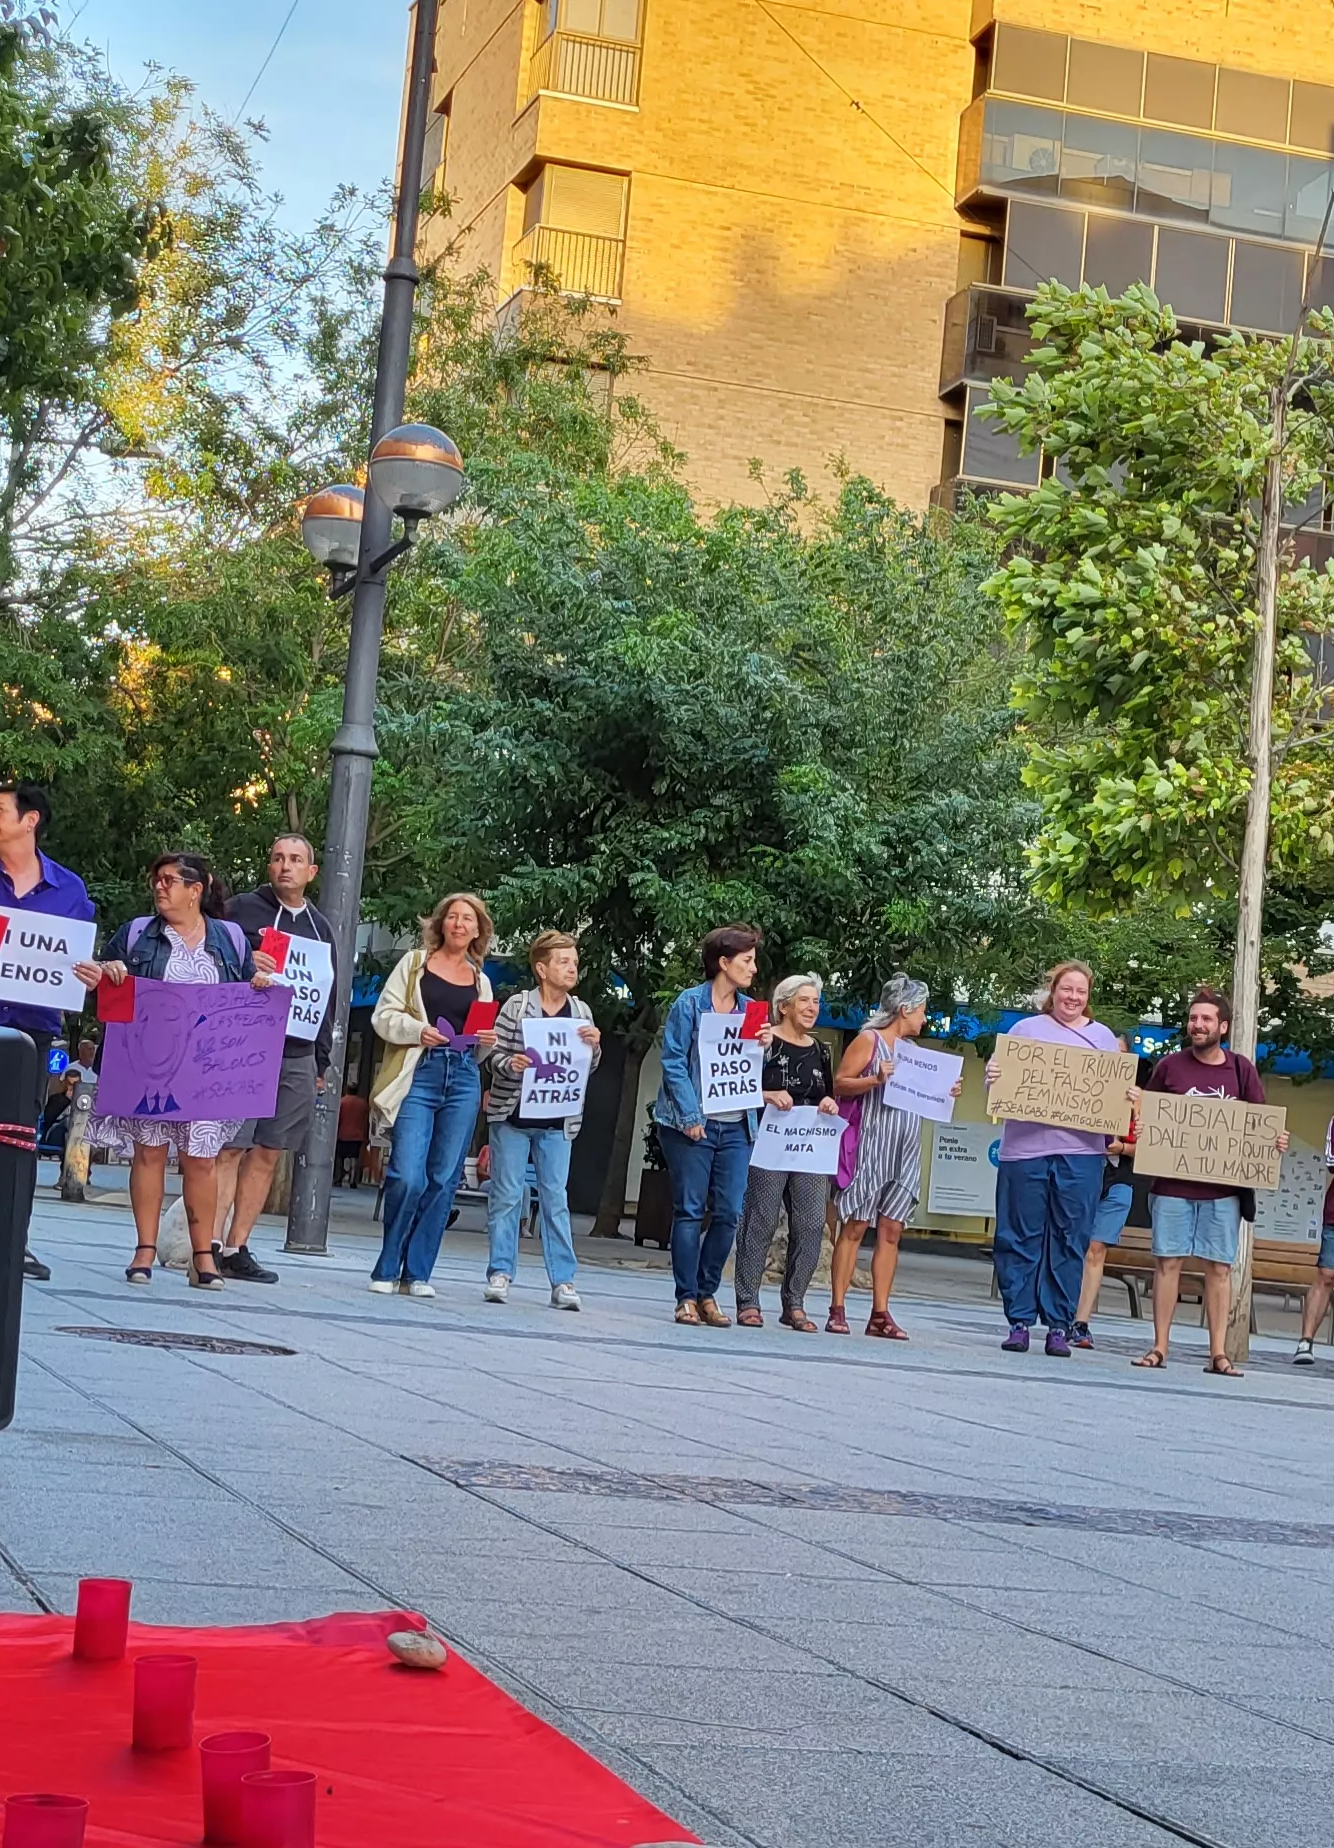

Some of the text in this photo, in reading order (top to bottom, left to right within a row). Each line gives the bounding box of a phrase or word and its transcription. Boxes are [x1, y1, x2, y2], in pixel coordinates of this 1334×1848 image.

[4, 929, 69, 955] I UNA
[289, 950, 307, 967] NI
[284, 968, 314, 983] UN
[292, 1005, 321, 1025] RÁS
[547, 1032, 567, 1046] NI
[718, 1042, 744, 1056] UN
[546, 1051, 572, 1065] UN
[1007, 1040, 1135, 1081] POR EL TRIUNFO
[710, 1060, 752, 1077] PASO
[1021, 1068, 1048, 1086] DEL
[526, 1086, 581, 1103] ATRÁS
[707, 1075, 757, 1098] ATRÁS
[1014, 1085, 1103, 1114] FEMINISMO
[766, 1123, 837, 1137] EL MACHISMO
[784, 1143, 814, 1153] MATA
[1149, 1125, 1280, 1161] DALE UN PIQUITO
[954, 1155, 978, 1163] verano
[1175, 1153, 1275, 1184] A TU MADRE
